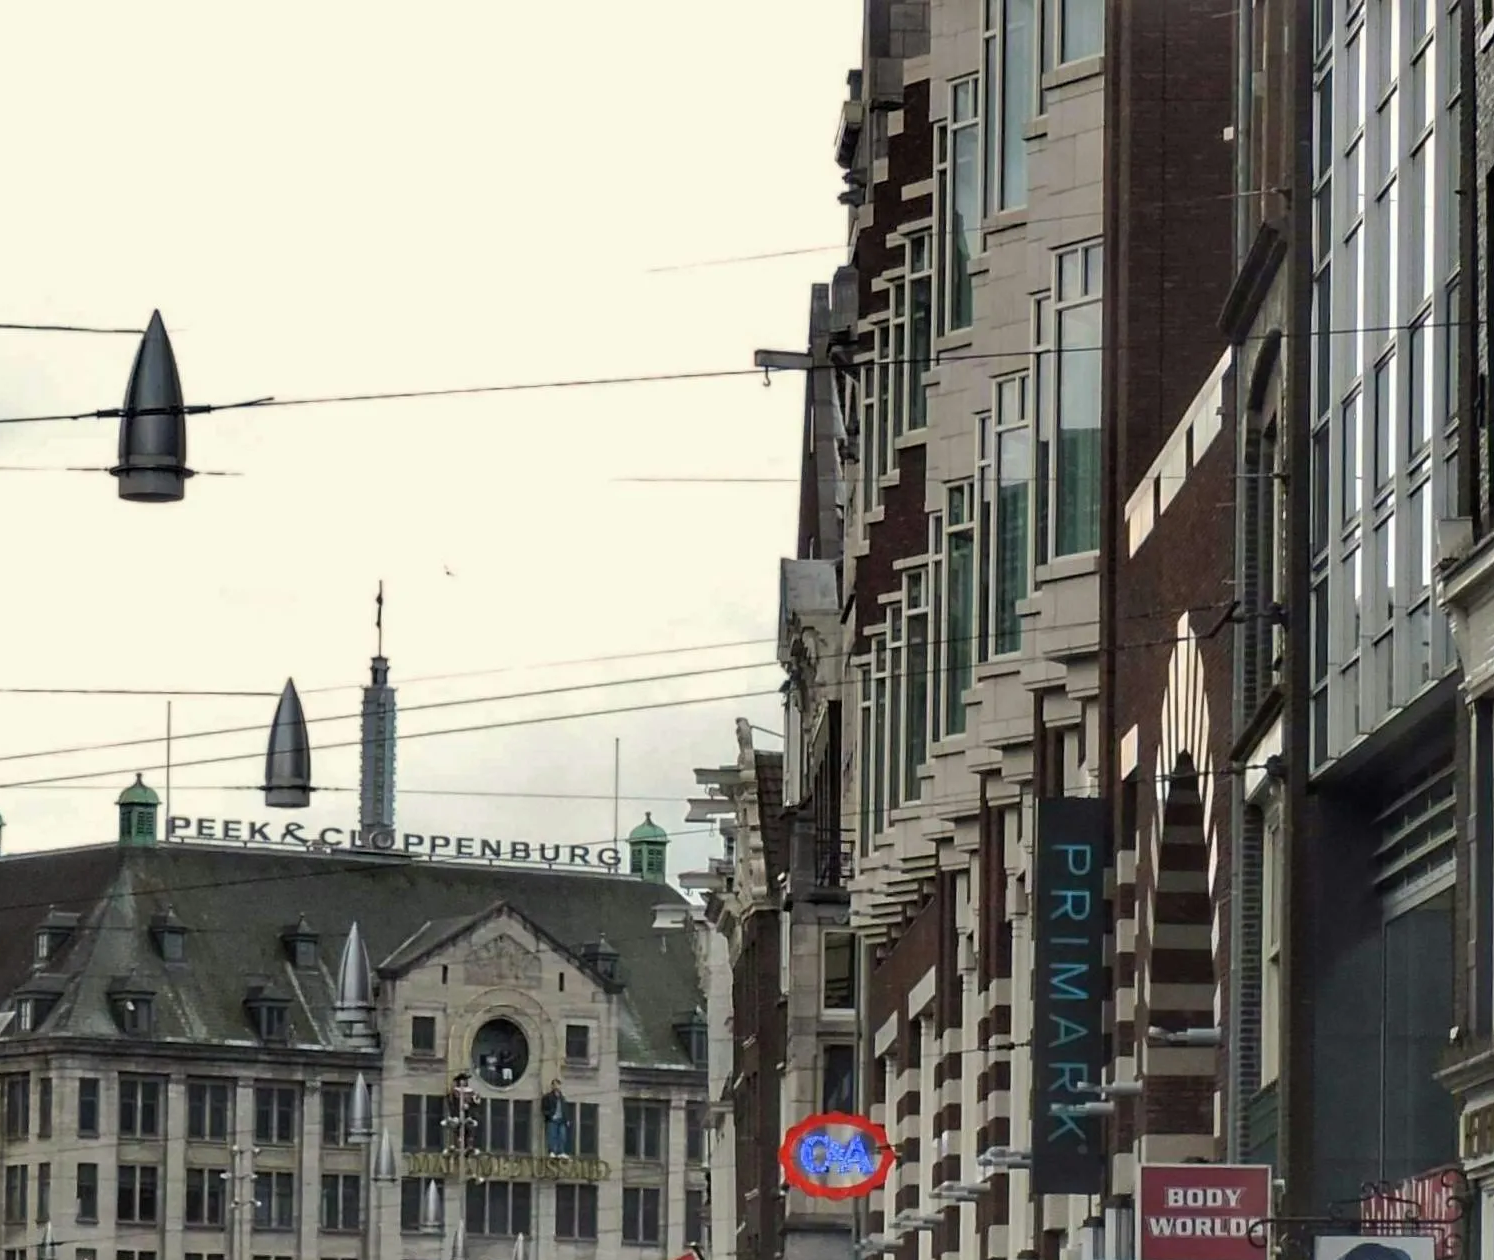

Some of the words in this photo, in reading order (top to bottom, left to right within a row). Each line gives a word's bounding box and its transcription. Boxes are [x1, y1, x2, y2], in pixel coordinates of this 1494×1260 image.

[170, 815, 272, 842] PEEK
[281, 822, 309, 846] &
[319, 826, 622, 867] CLOPPENBURG
[1048, 843, 1091, 1144] PRIMARK
[800, 1133, 875, 1175] C&A
[1167, 1187, 1243, 1209] BODY
[1149, 1217, 1265, 1238] WORLDS
